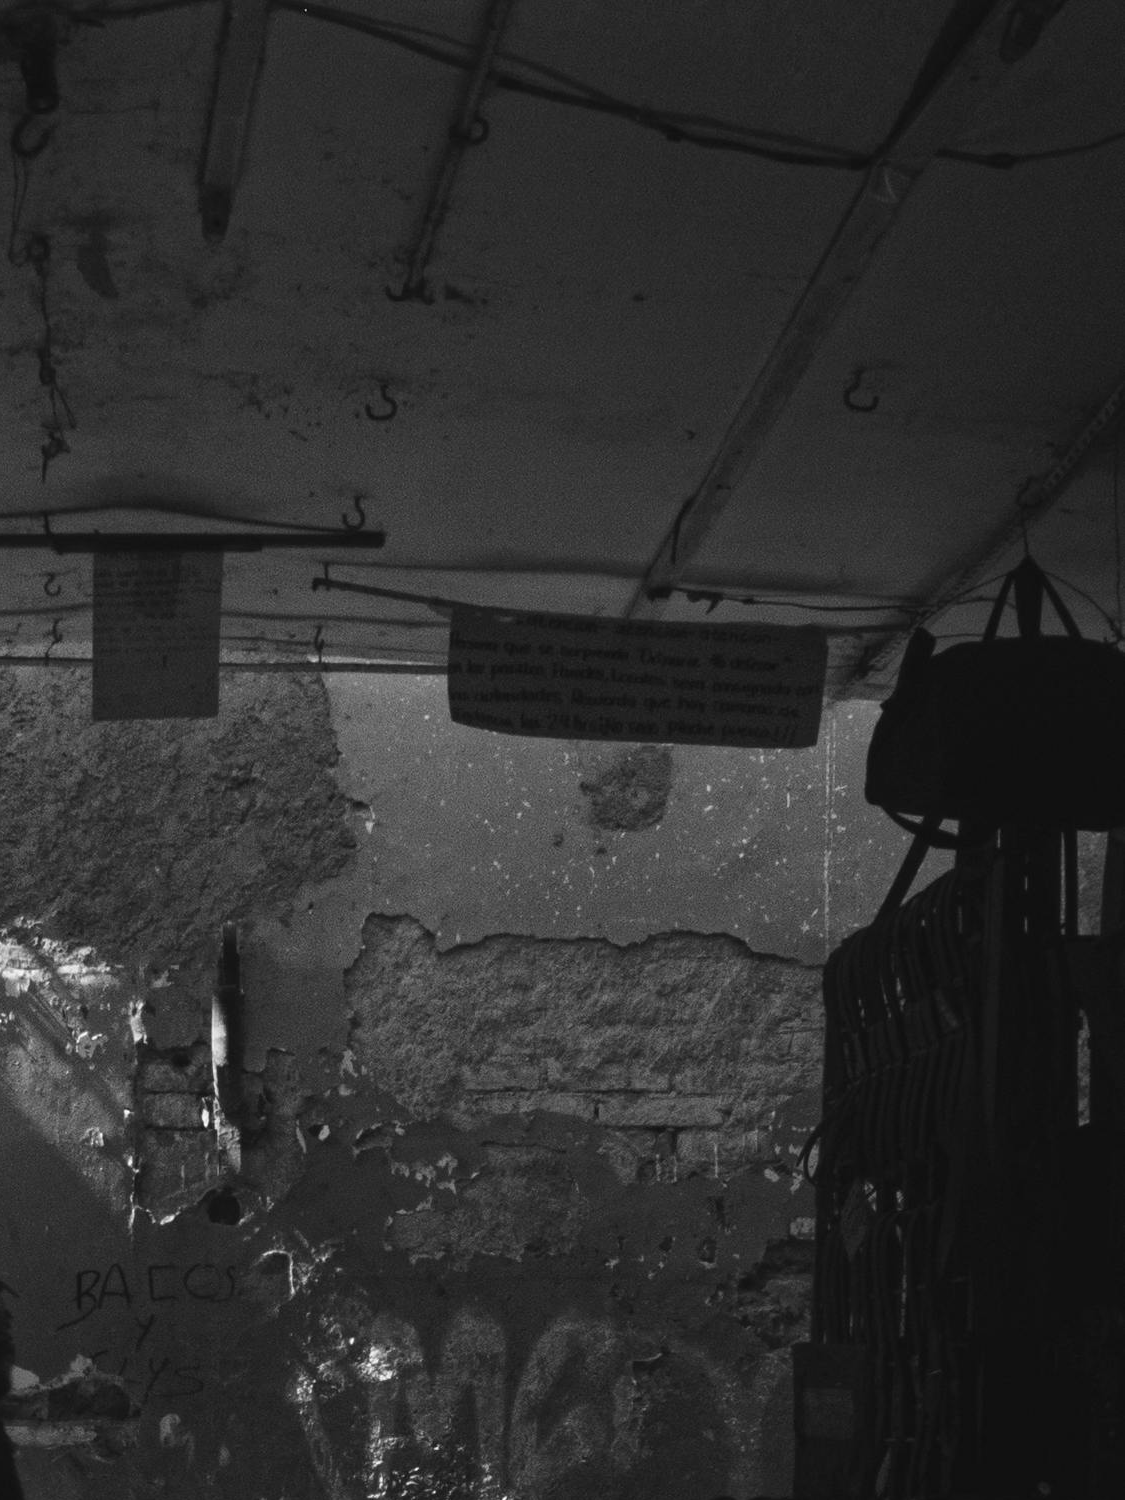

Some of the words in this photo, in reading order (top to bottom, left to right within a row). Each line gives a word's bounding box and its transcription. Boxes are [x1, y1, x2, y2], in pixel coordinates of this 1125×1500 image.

[502, 641, 532, 657] que
[643, 696, 673, 713] que
[135, 1314, 155, 1352] Y
